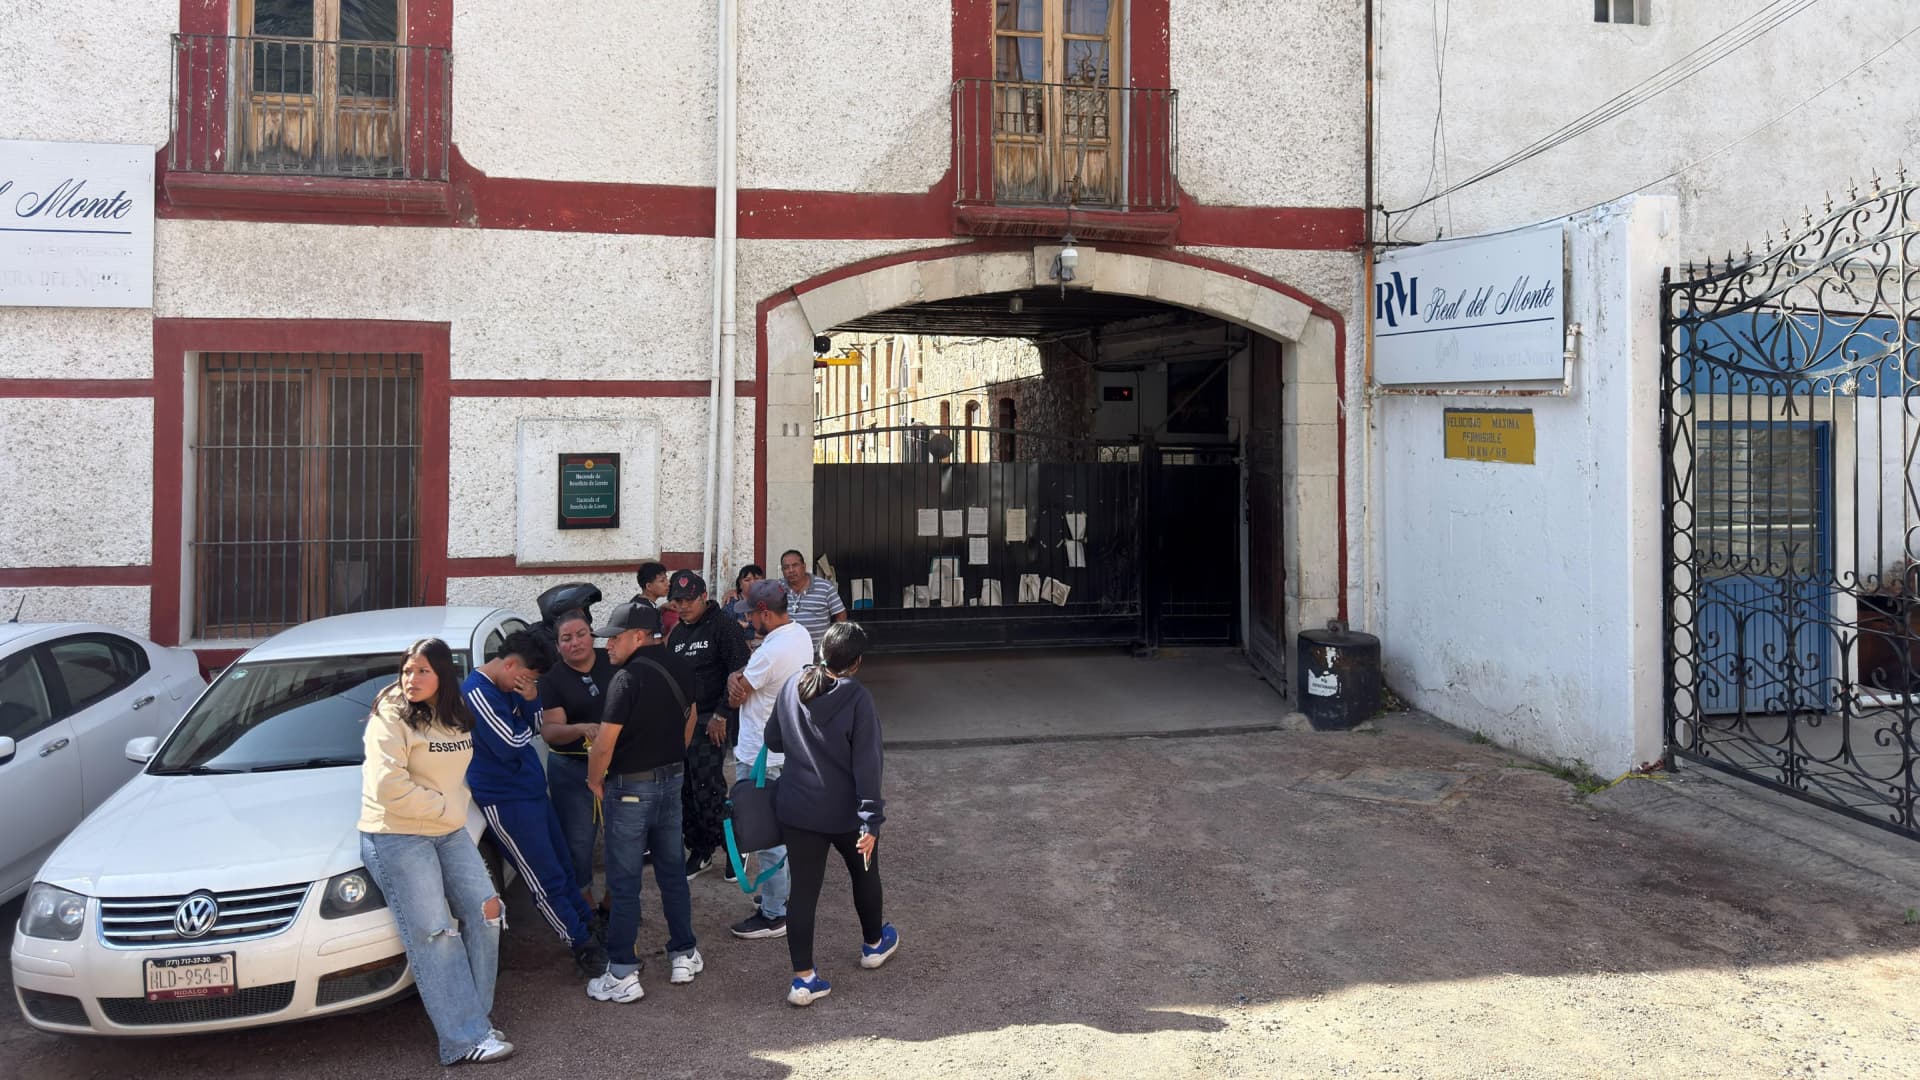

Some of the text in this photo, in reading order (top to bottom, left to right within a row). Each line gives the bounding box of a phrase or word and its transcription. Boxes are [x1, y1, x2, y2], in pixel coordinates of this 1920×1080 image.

[15, 178, 133, 220] Monte
[1375, 271, 1556, 327] RM Real del Monte
[174, 988, 208, 996] HIDALGO
